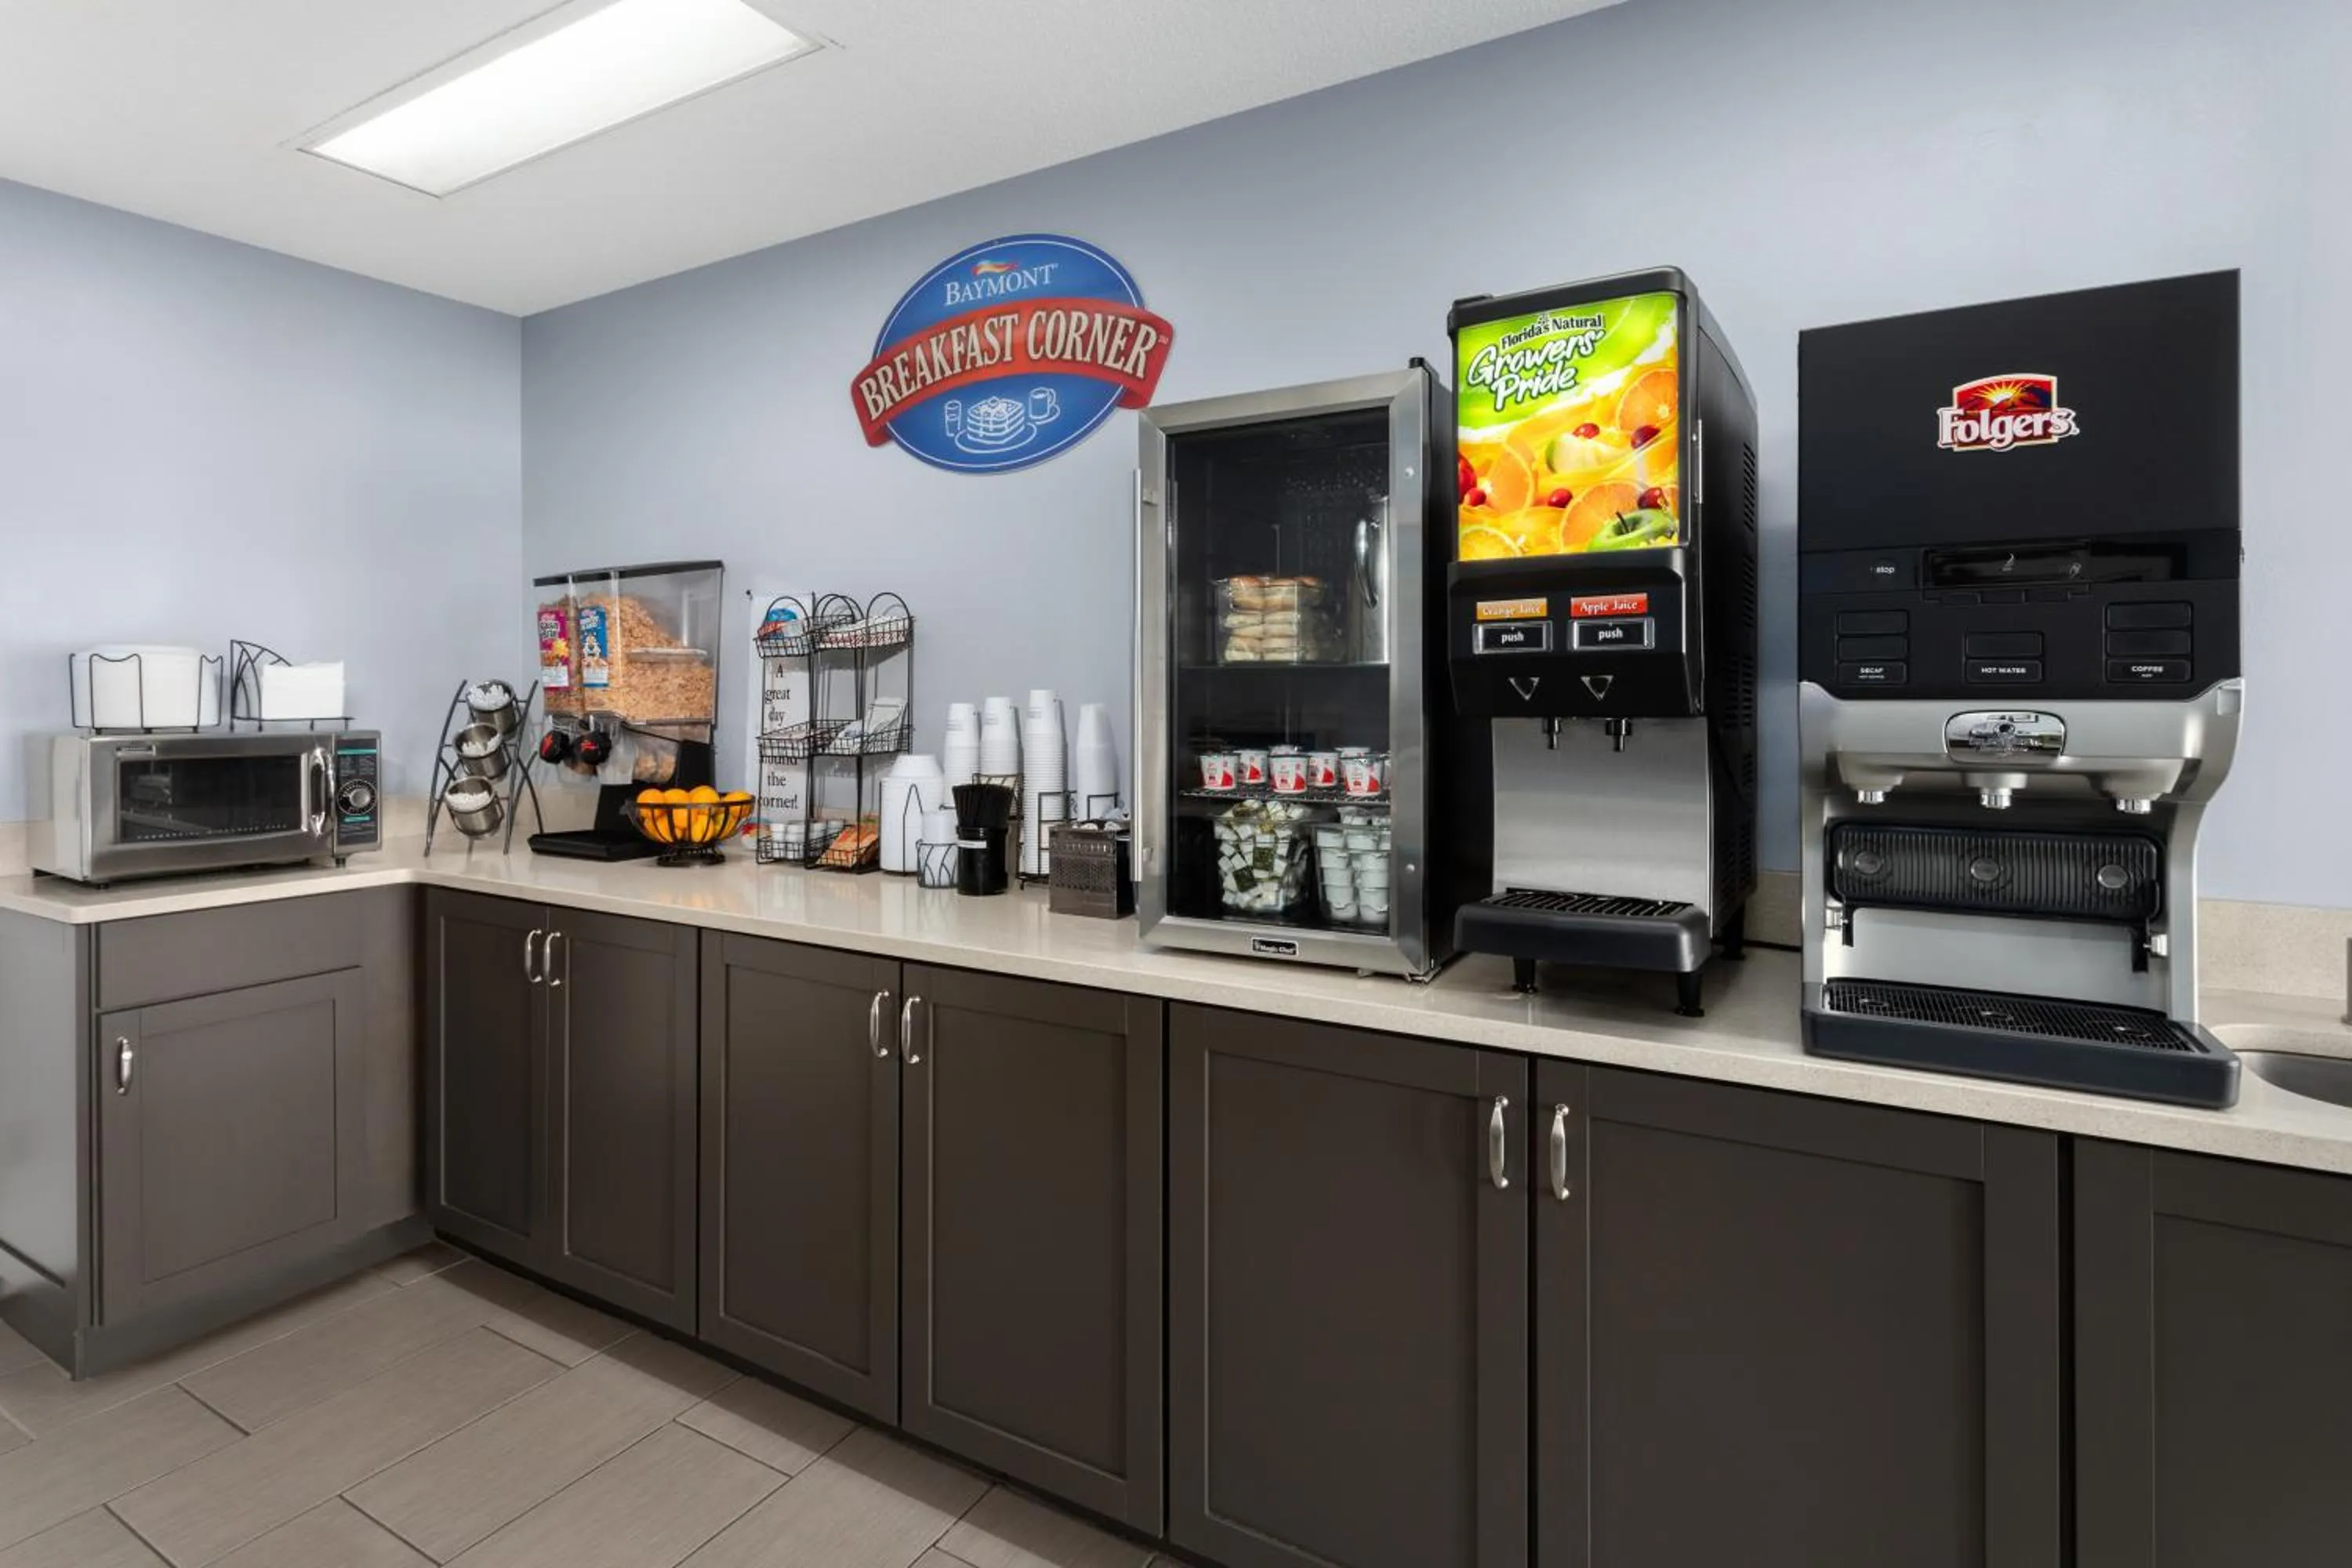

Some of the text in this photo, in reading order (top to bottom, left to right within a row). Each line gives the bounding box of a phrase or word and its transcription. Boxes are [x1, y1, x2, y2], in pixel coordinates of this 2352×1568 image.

[944, 264, 1055, 307] BAYMONT
[1552, 314, 1602, 330] Natural
[860, 310, 1157, 421] BREAKFAST CORNER
[1491, 360, 1577, 412] Pride
[1937, 407, 2078, 452] Folgers
[1875, 565, 1896, 574] stop
[1580, 600, 1639, 615] Apple Juice
[1501, 630, 1525, 644] push
[1599, 628, 1624, 641] push
[775, 664, 783, 678] A
[764, 689, 790, 704] great
[767, 771, 787, 786] the
